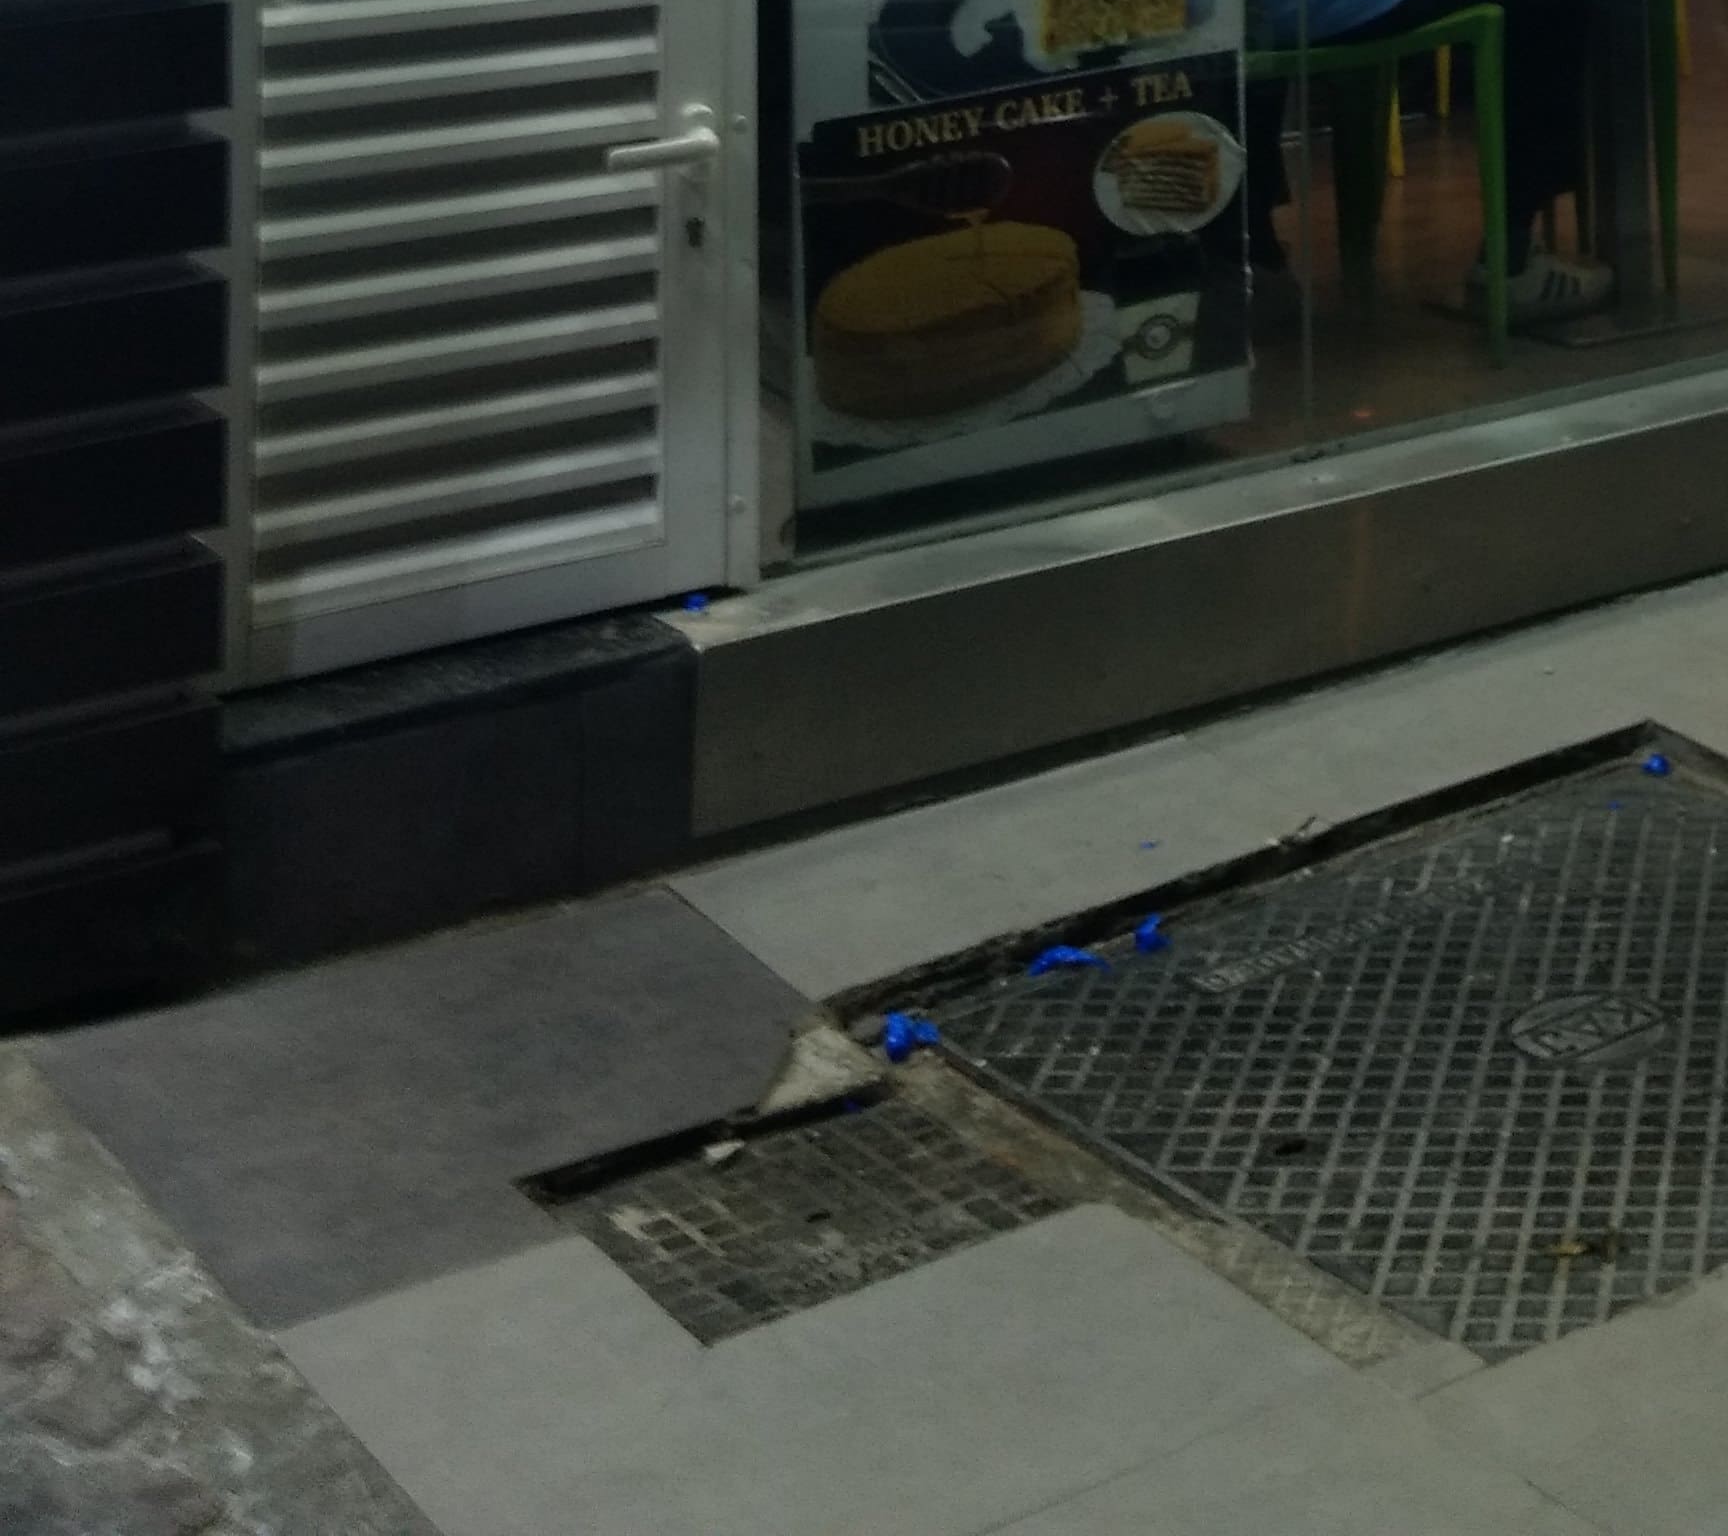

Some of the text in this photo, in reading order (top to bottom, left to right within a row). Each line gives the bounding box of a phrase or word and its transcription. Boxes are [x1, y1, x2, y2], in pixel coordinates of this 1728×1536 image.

[857, 106, 985, 158] HONEY
[995, 88, 1085, 130] CAKE
[1131, 70, 1194, 107] TEA
